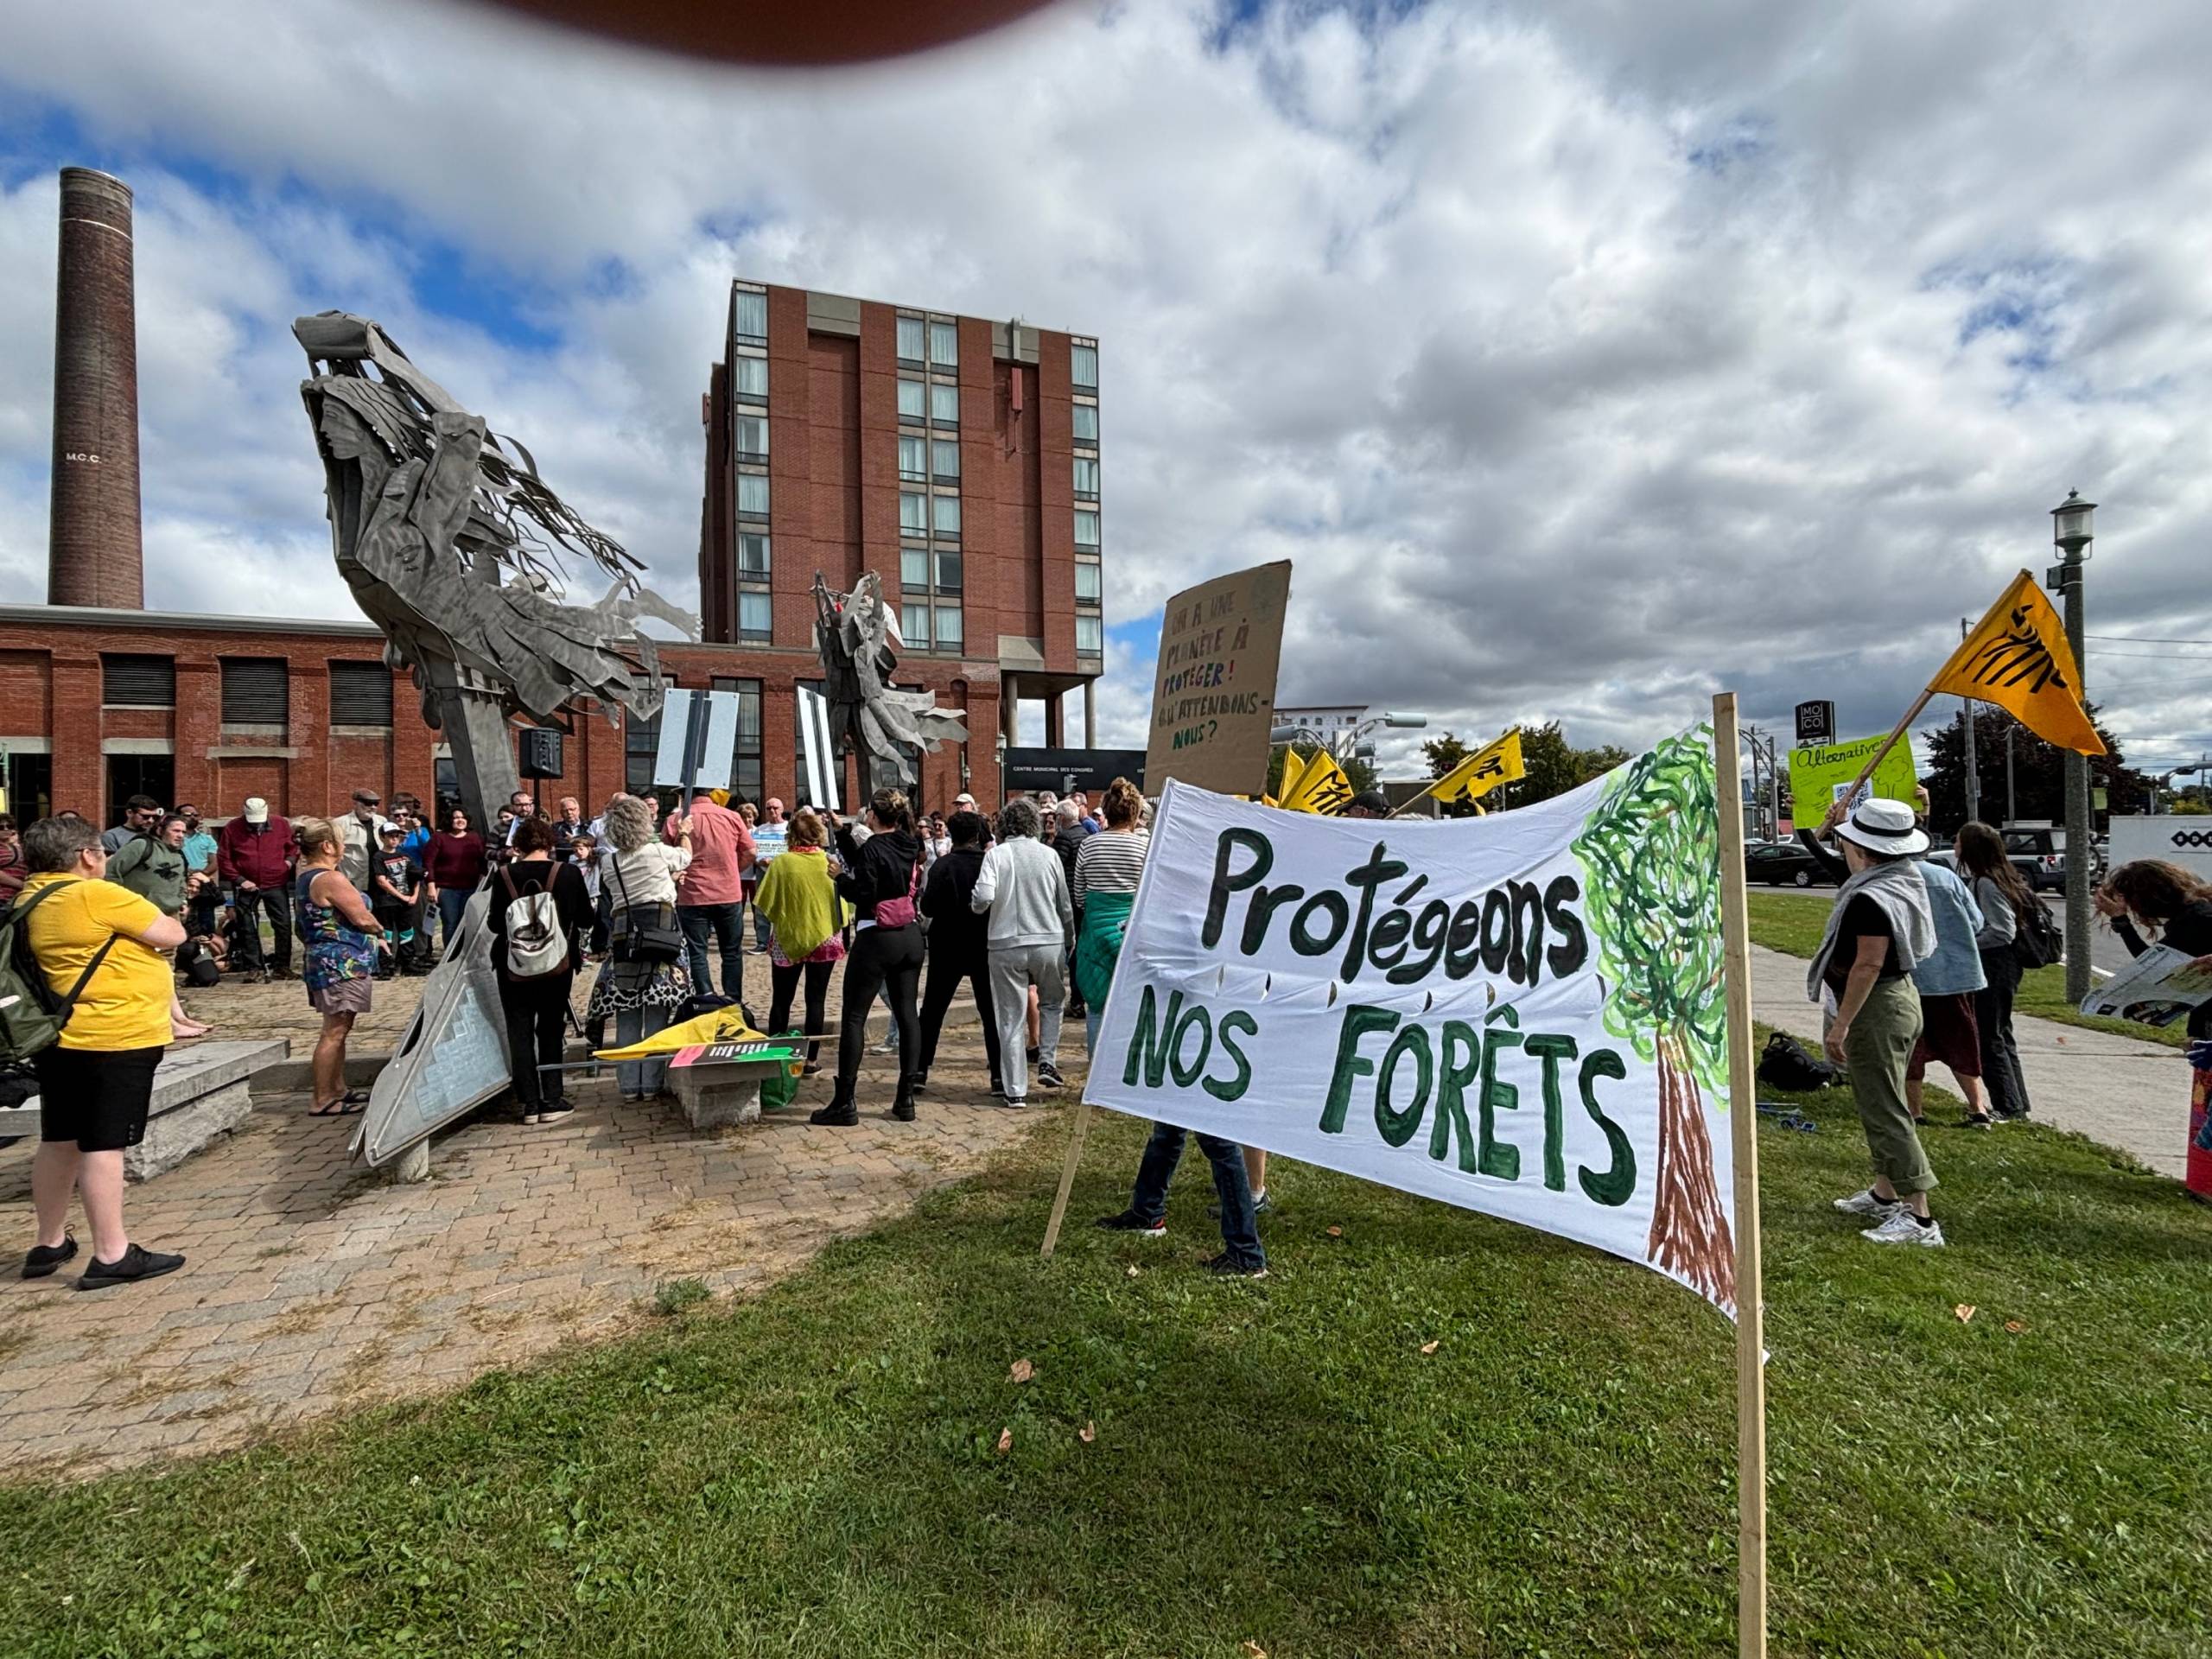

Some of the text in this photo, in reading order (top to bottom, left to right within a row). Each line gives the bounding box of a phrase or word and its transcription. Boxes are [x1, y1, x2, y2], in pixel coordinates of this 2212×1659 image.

[66, 453, 102, 464] M.C.C.
[1192, 602, 1202, 627] A
[1210, 590, 1236, 618] UNE
[1803, 706, 1821, 716] MO
[1804, 717, 1822, 728] CO
[1201, 827, 1589, 988] Protégeons
[1123, 984, 1637, 1207] NOS FORÊTS
